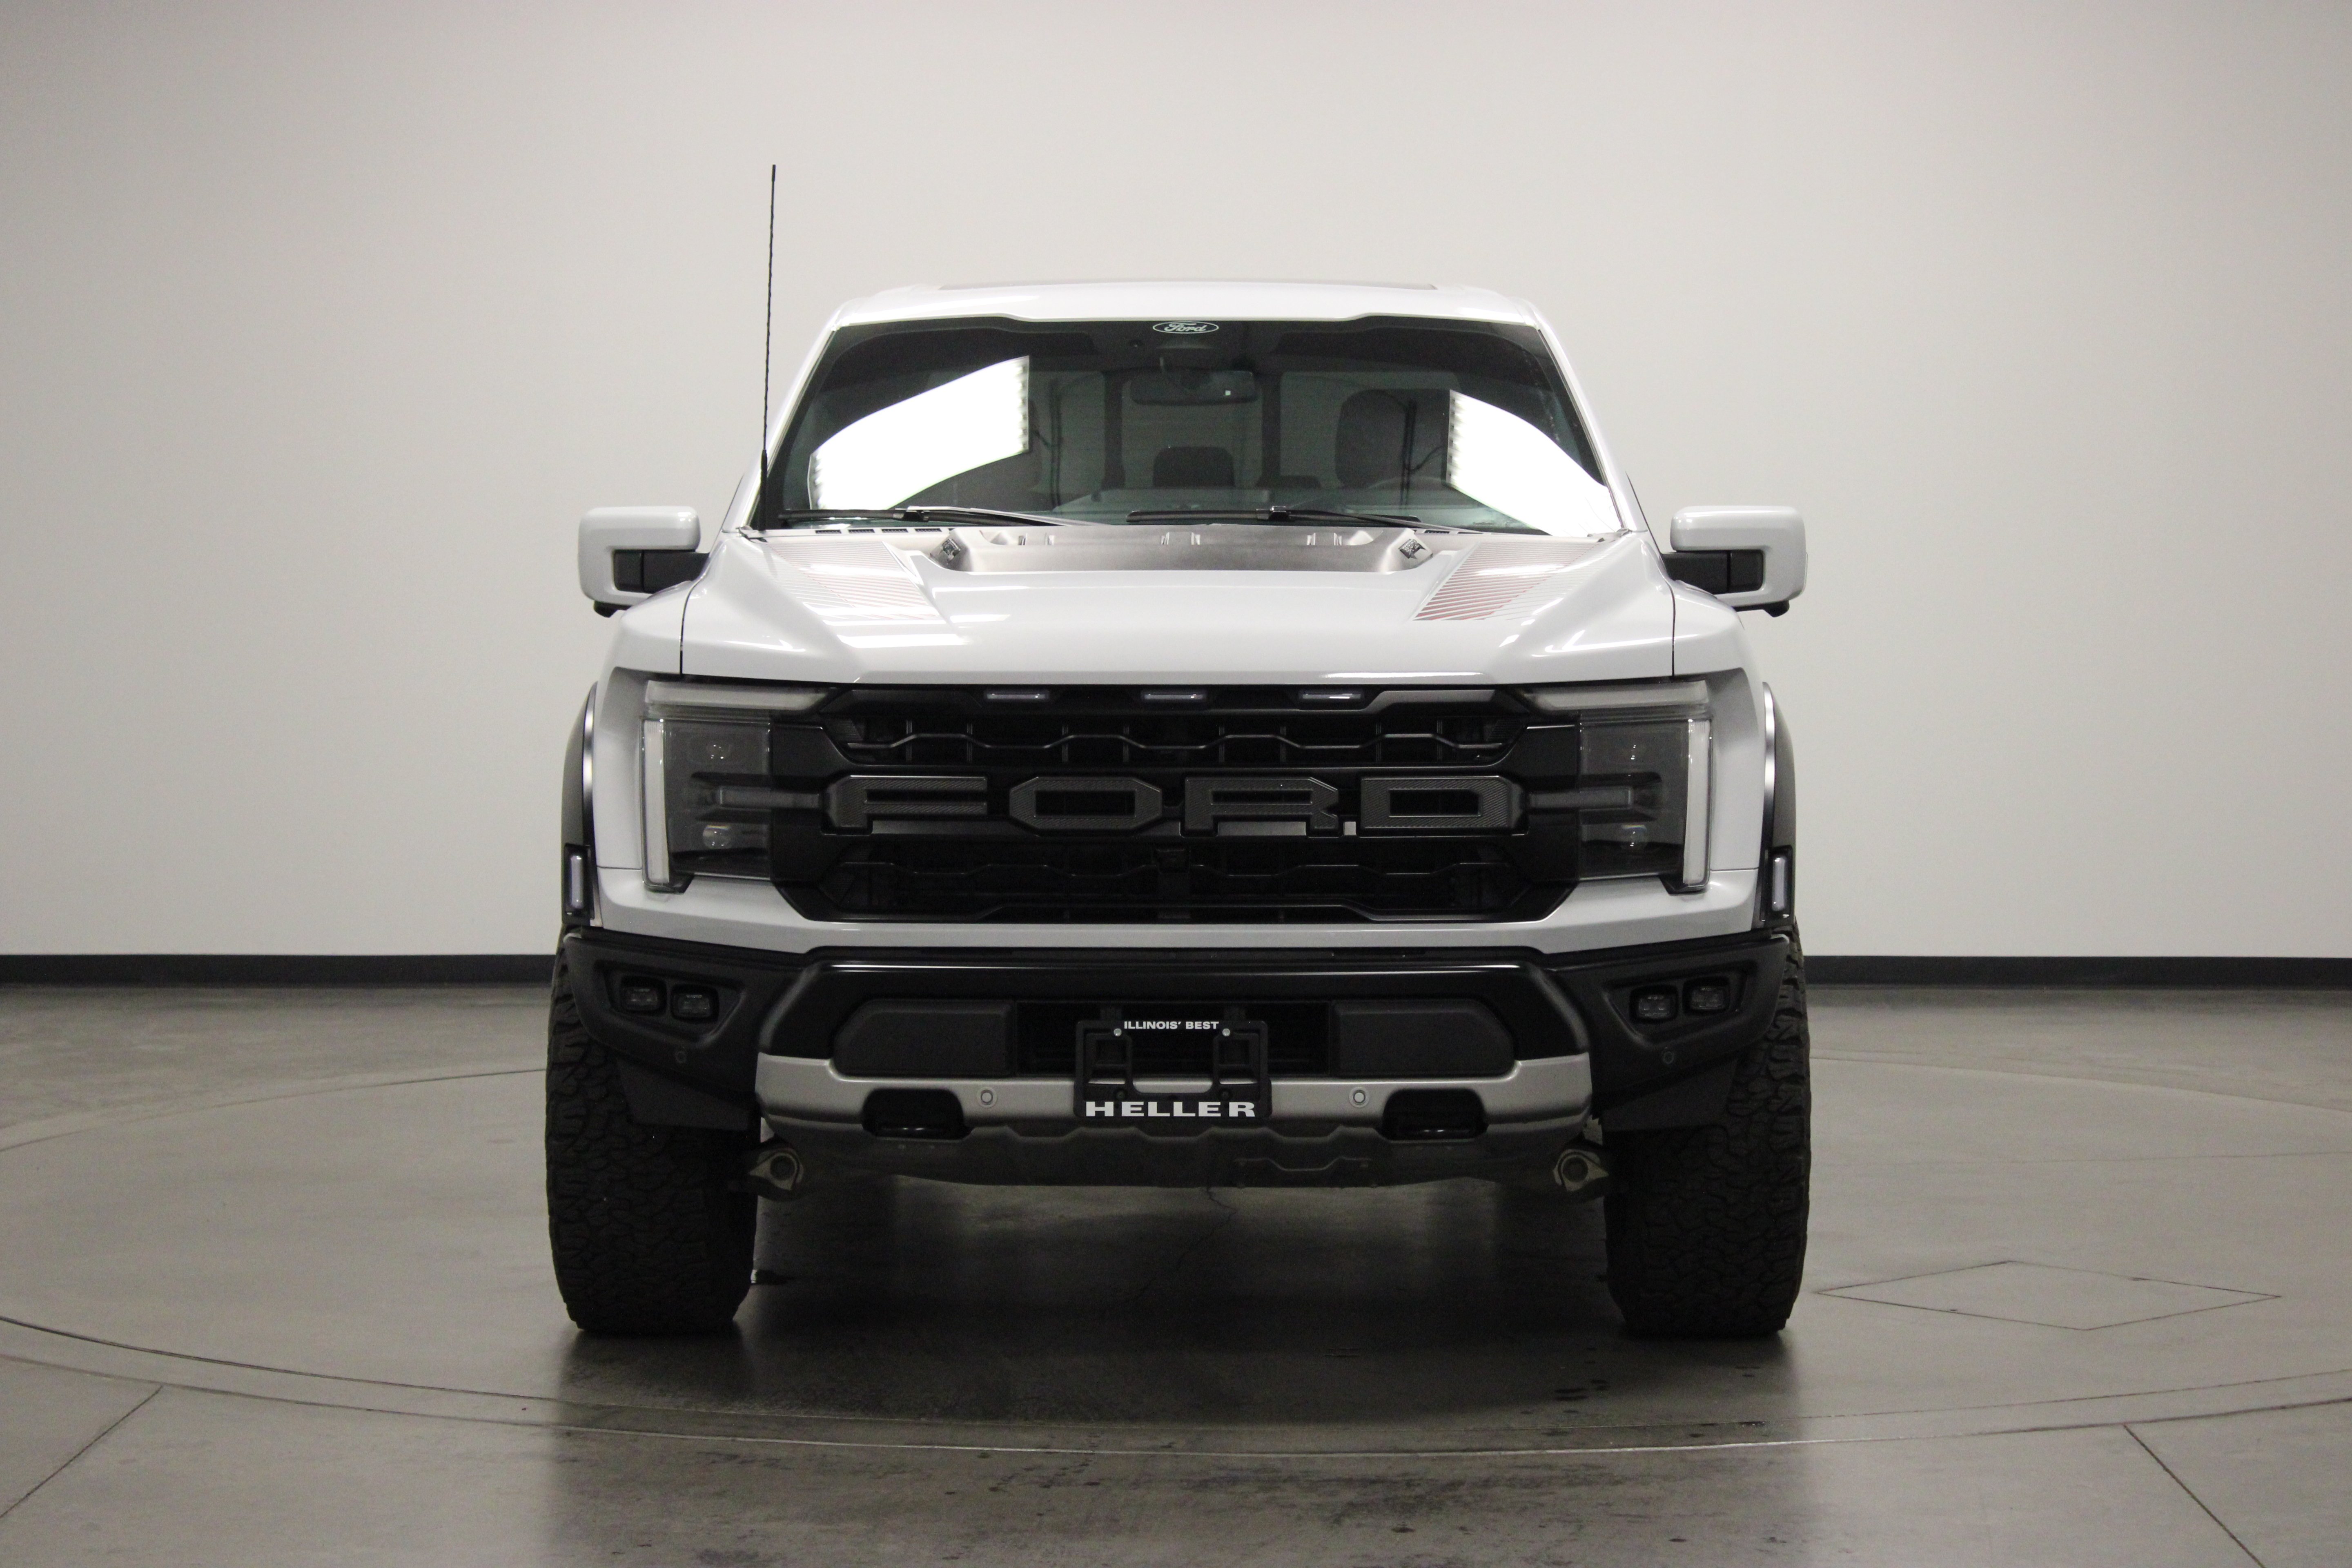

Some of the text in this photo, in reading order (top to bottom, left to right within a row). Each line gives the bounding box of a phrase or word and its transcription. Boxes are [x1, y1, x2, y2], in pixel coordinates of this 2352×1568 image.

[1164, 323, 1207, 332] Ford
[826, 775, 1521, 831] FORD
[1086, 1102, 1255, 1117] HELLER
